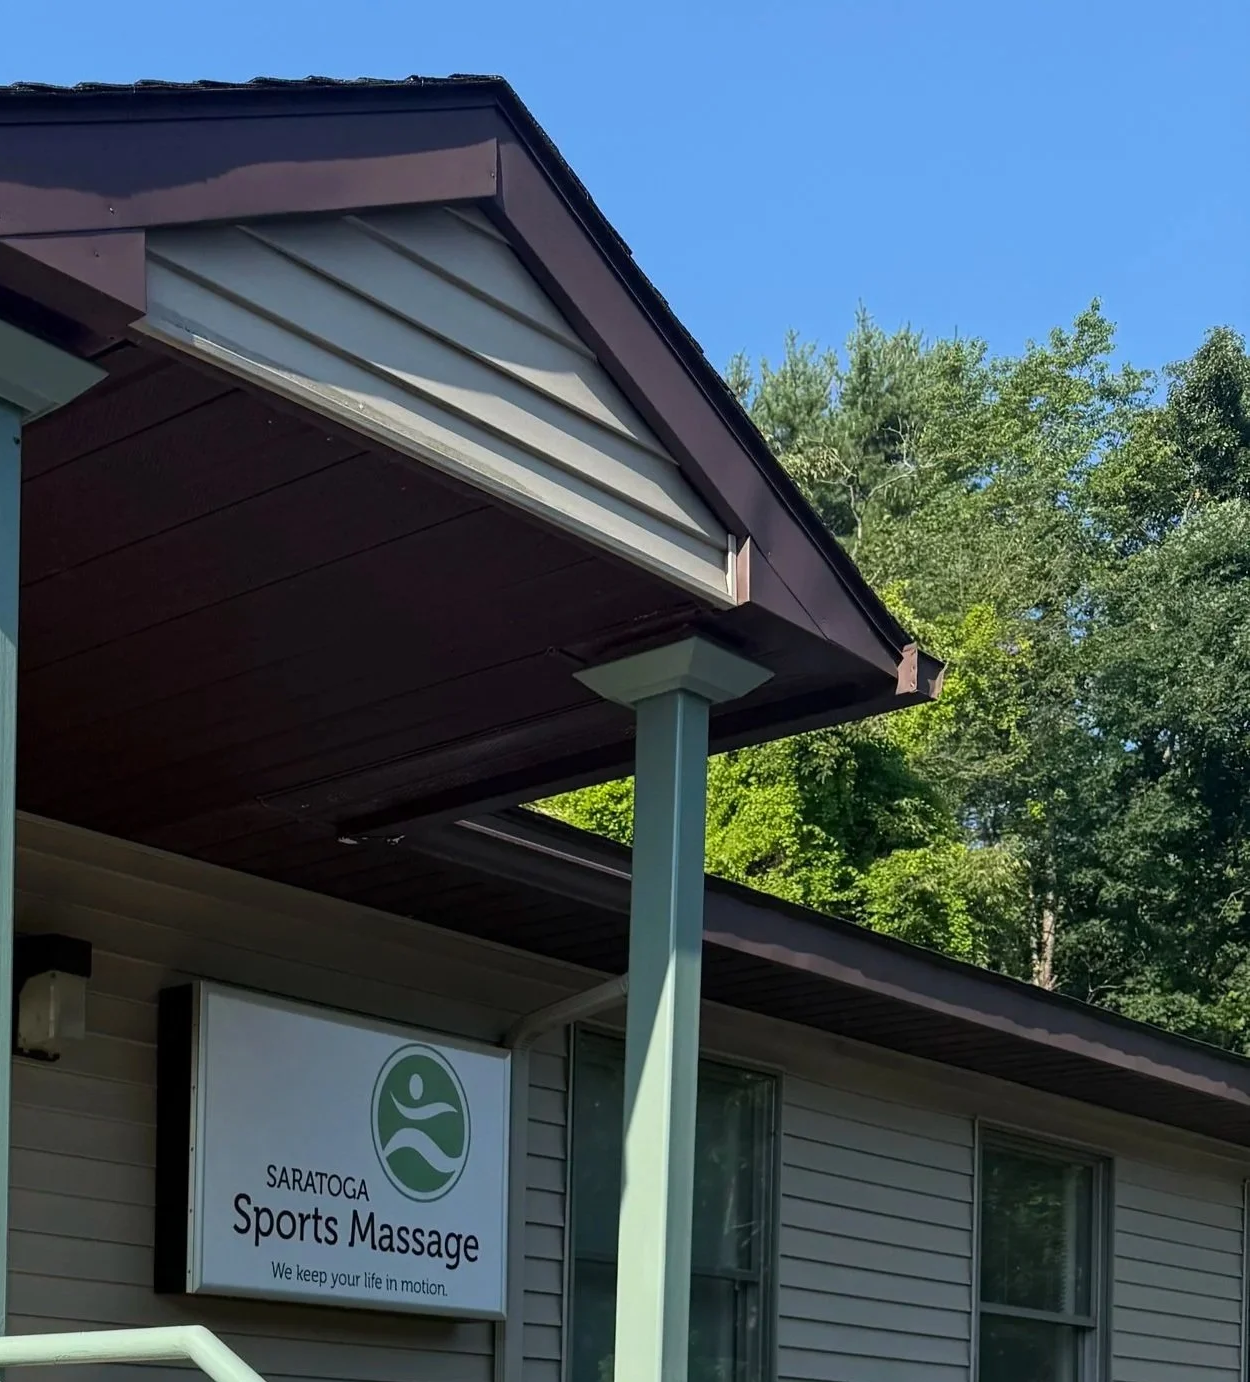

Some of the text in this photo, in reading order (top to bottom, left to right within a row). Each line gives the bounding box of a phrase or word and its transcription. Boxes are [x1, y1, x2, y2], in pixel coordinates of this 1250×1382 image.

[266, 1164, 370, 1202] SARATOGA
[233, 1193, 479, 1270] Sports Massage
[272, 1261, 448, 1297] We keep your life in motion.
